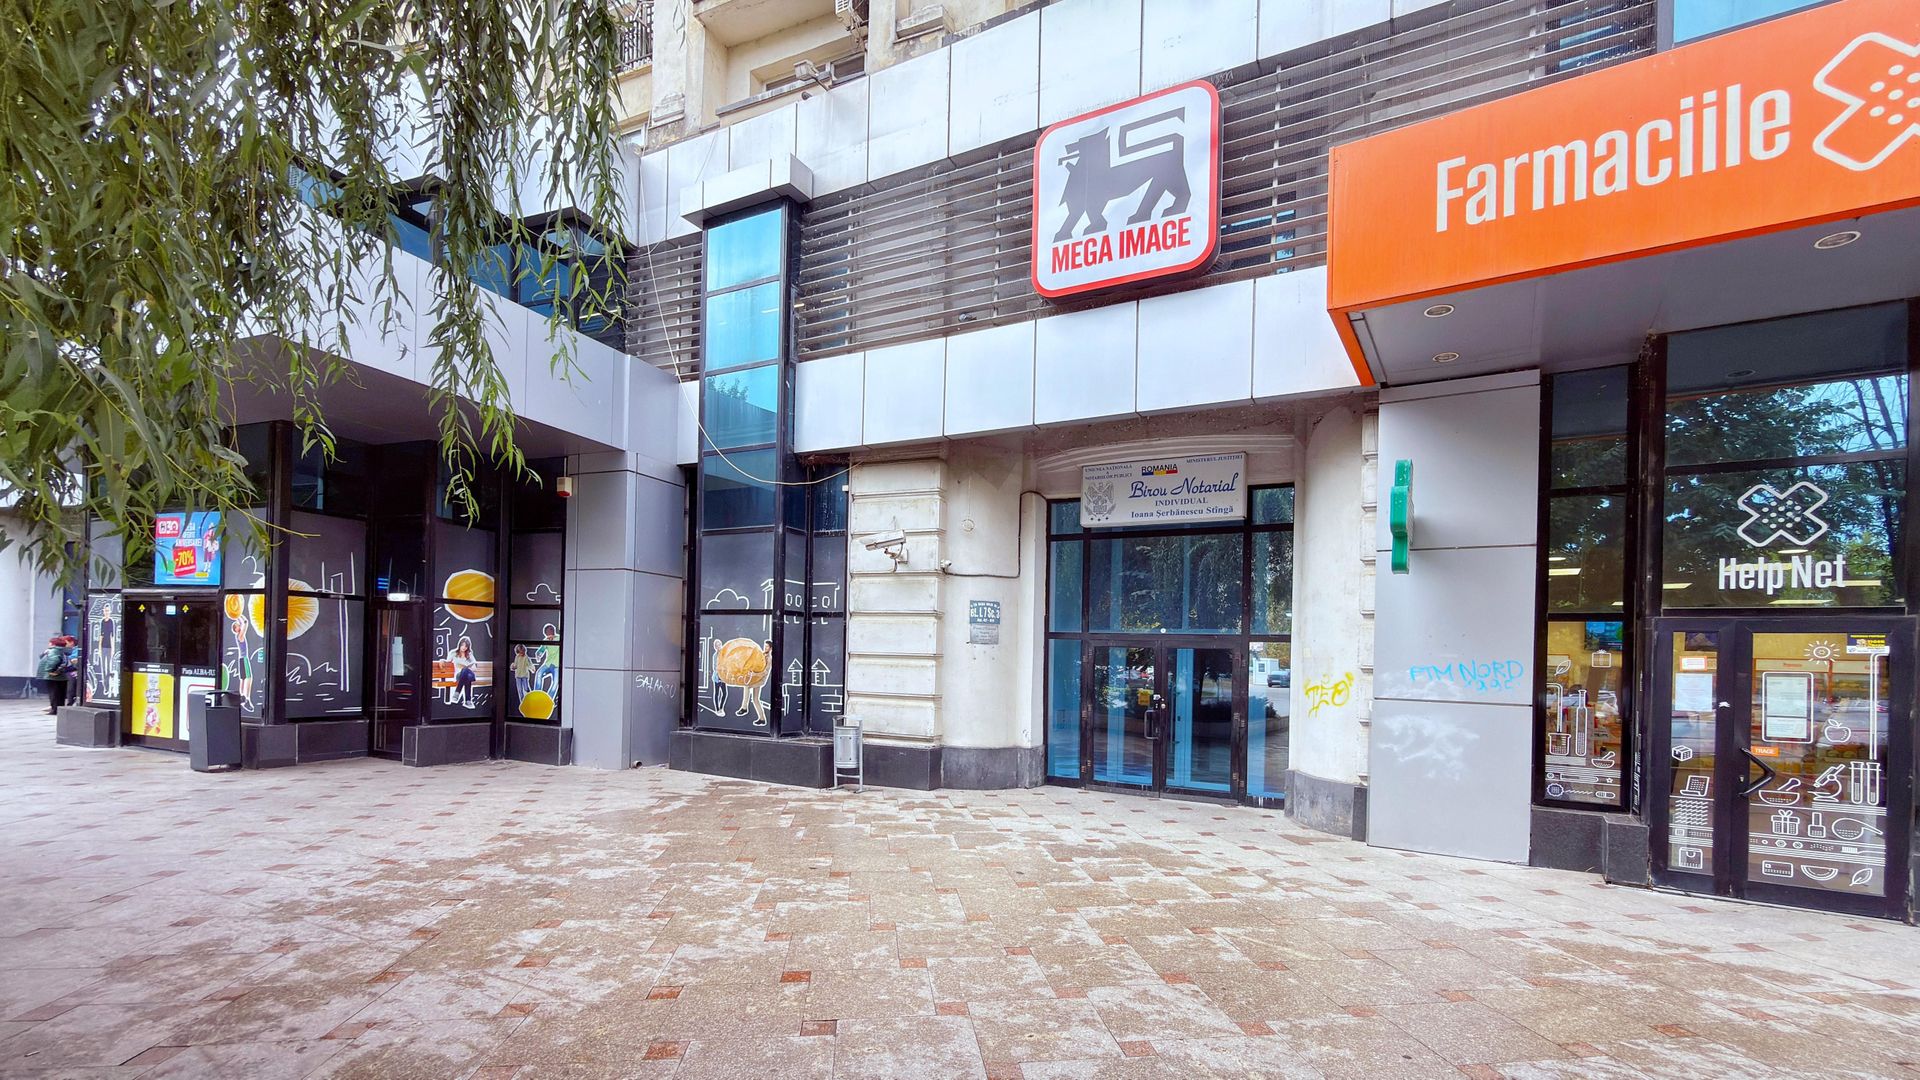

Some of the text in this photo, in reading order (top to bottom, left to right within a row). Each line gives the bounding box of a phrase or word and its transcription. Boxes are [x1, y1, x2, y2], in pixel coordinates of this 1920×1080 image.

[1436, 83, 1791, 233] Farmaciile
[1051, 216, 1192, 274] MEGA IMAGE
[1128, 472, 1239, 498] Birou Notarial
[1155, 496, 1209, 507] INDIVIDUAL
[1131, 510, 1154, 518] Ioana
[175, 550, 194, 567] -70%
[1718, 554, 1847, 595] Help Net
[1458, 659, 1524, 681] NORD
